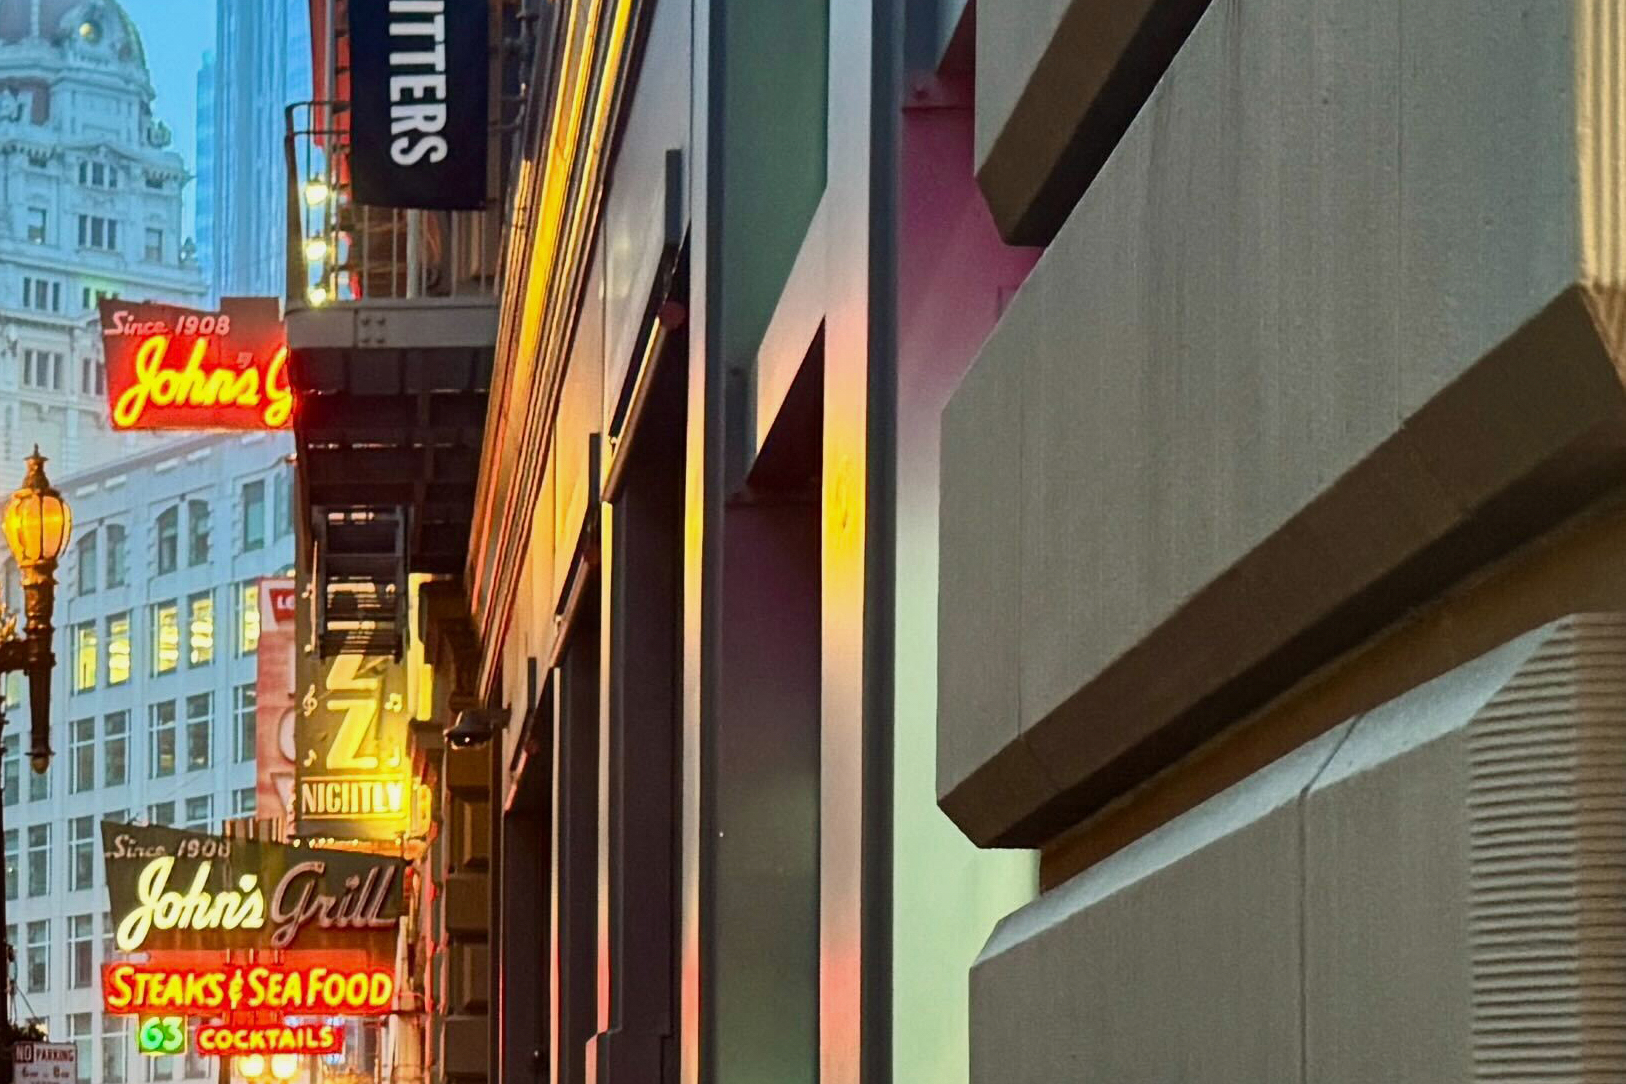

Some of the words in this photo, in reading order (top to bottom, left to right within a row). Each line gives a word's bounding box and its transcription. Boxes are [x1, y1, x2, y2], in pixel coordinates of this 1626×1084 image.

[104, 310, 169, 336] Since
[175, 315, 231, 336] 1908
[113, 334, 262, 427] John's
[300, 781, 404, 813] NIGHTLY
[104, 833, 166, 858] Since
[116, 855, 266, 952] John's
[271, 860, 397, 948] Grill
[108, 965, 226, 1008] STEAKS
[228, 968, 244, 1010] &
[139, 1016, 184, 1051] 63
[199, 1026, 335, 1050] COCKTAILS
[16, 1044, 33, 1062] NO
